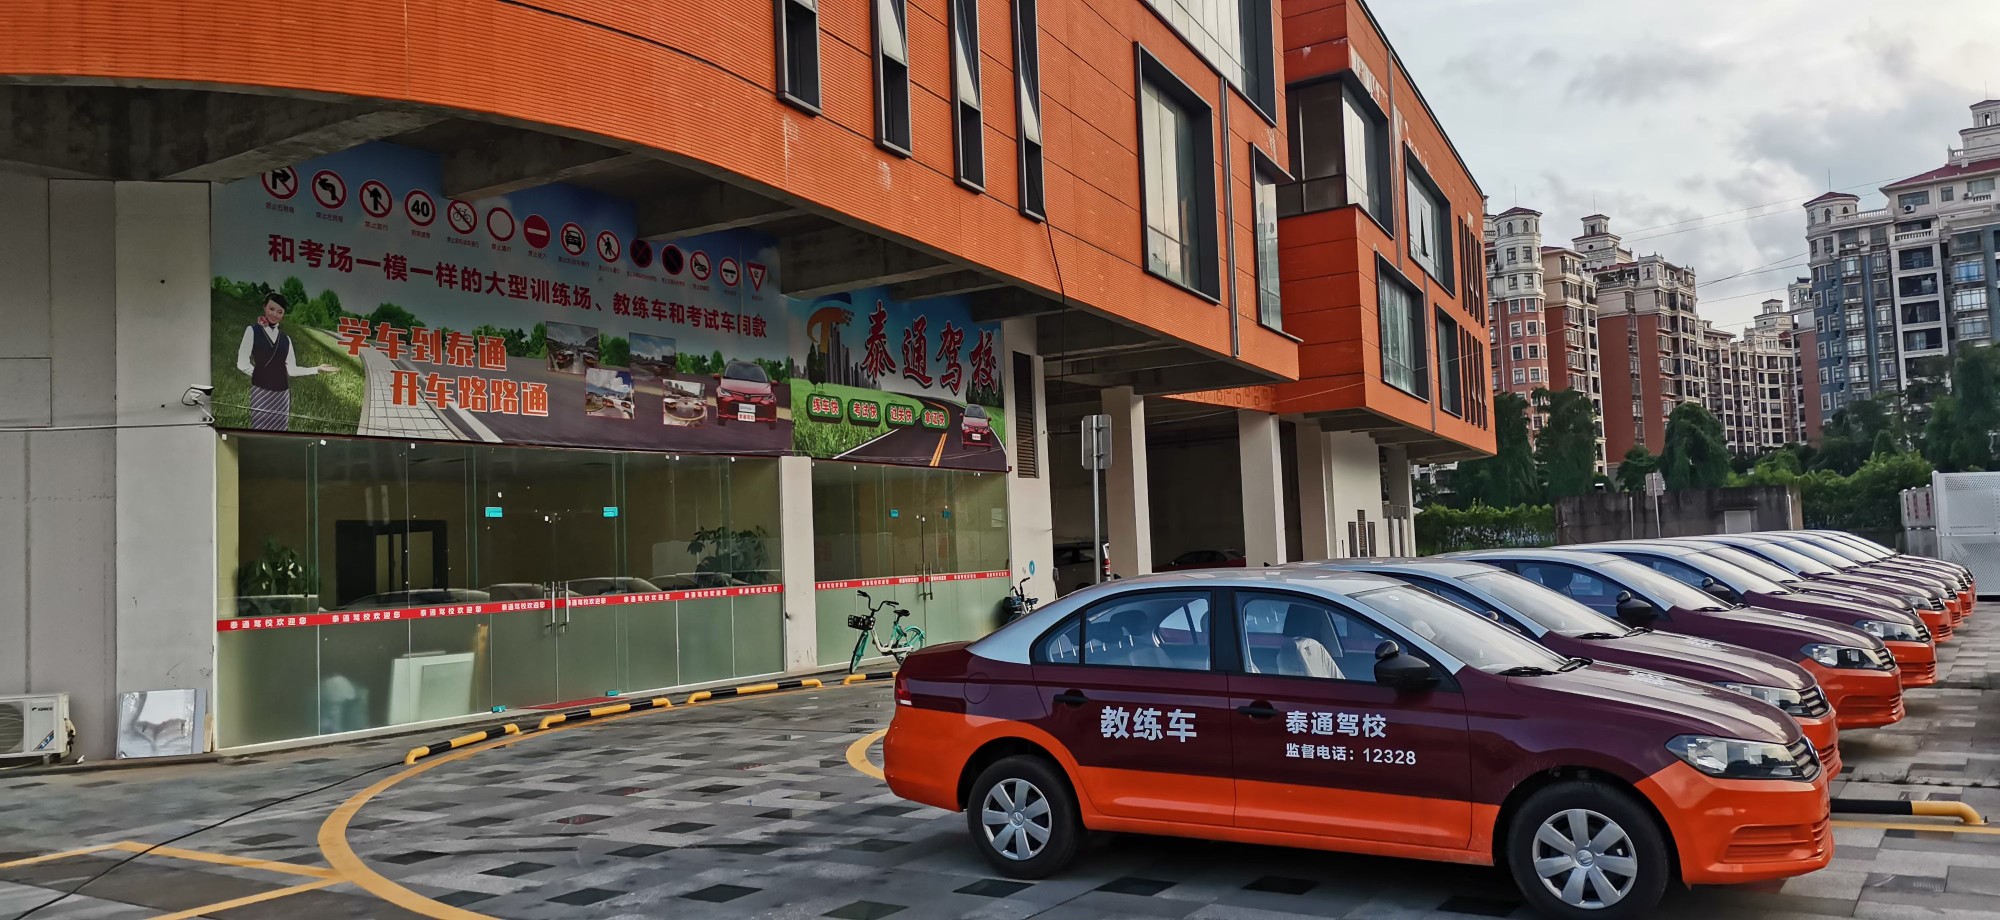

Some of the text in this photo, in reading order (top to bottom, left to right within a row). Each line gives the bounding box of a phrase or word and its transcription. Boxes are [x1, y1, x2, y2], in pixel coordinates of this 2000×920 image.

[410, 199, 430, 218] 40
[268, 234, 767, 338] 和考场一模一样的大型训练场、教练车和考试车同款
[337, 316, 507, 371] 学车到泰通
[861, 299, 998, 395] 泰通驾校
[390, 369, 549, 417] 开车路路通
[812, 397, 840, 415] 练车快
[852, 402, 878, 420] 考试快
[890, 406, 914, 423] 过关快
[230, 617, 307, 630] 泰通驾校欢迎您
[332, 611, 401, 623] 泰通驾校欢迎您
[420, 605, 482, 617] 泰通驾校欢迎您
[1100, 706, 1197, 743] 教练车
[1286, 711, 1387, 739] 泰通驾校
